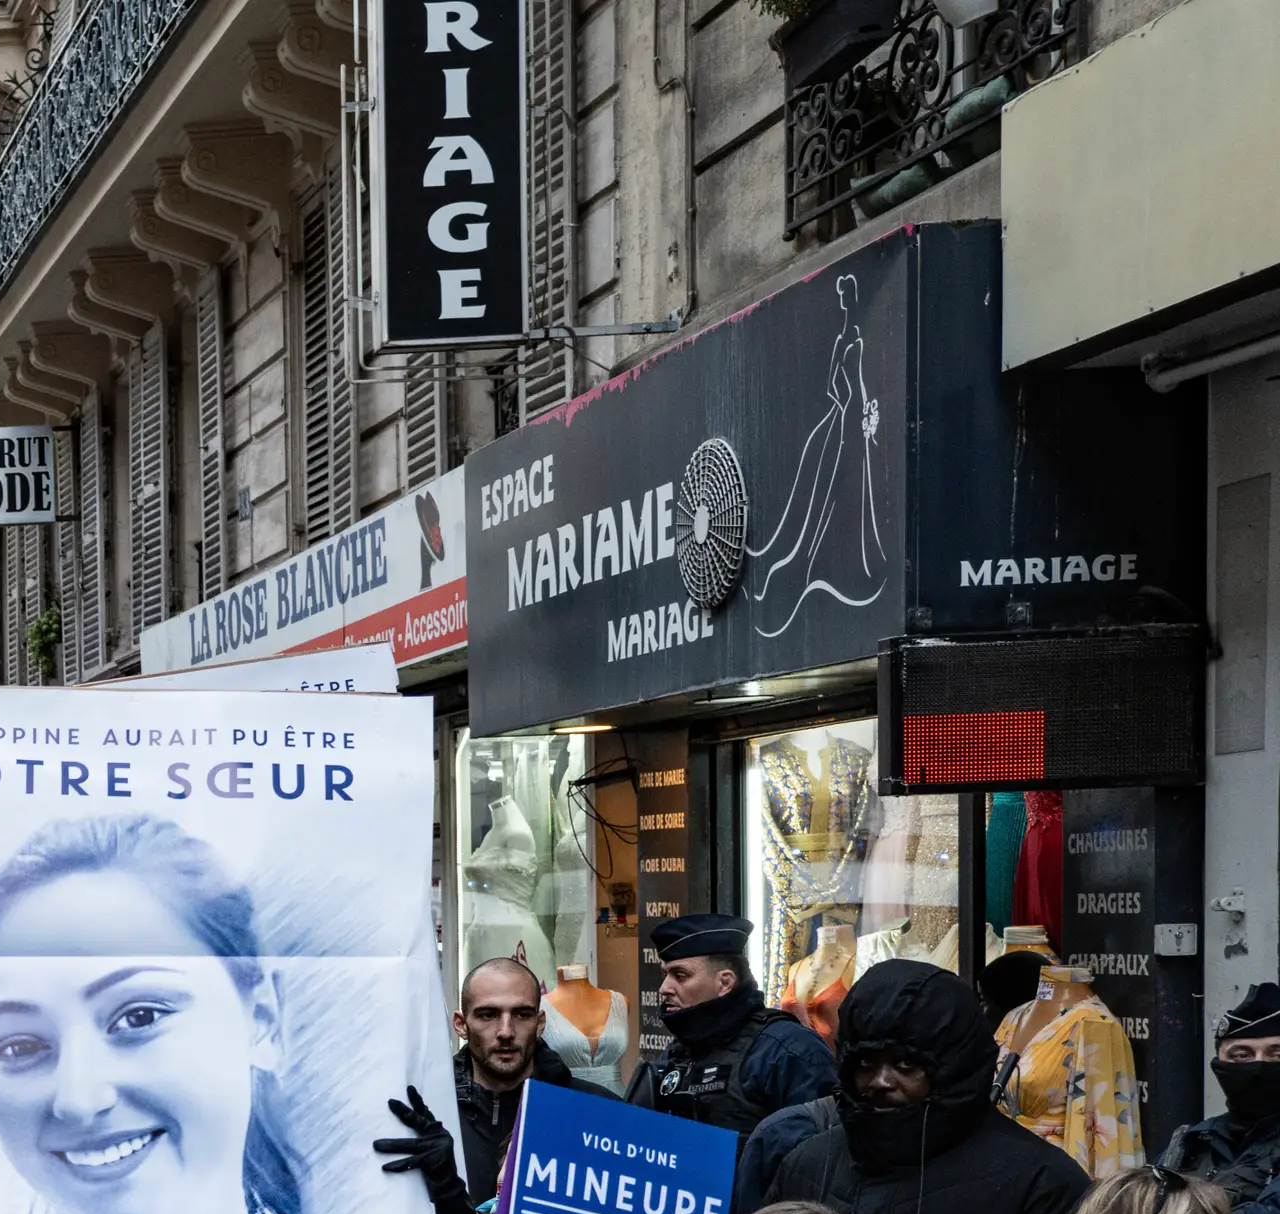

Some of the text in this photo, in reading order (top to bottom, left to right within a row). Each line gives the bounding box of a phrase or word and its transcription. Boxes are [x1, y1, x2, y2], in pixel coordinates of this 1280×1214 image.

[423, 1, 494, 319] RIAGE
[481, 454, 555, 531] ESPACE
[507, 482, 676, 612] MARIAME
[960, 554, 1137, 587] MARIAGE
[189, 517, 387, 665] LA ROSE BLANCHE
[608, 598, 714, 662] MARIAGE
[102, 727, 217, 746] AURAIT
[232, 729, 268, 746] PU
[284, 725, 355, 749] ÊTRE
[166, 761, 355, 801] SŒUR
[640, 812, 685, 831] ROBE DE SOIREE
[1068, 828, 1148, 855] CHAUSSURES
[640, 857, 685, 872] ROBE DUBAI
[646, 902, 679, 918] KAFTAN
[1077, 892, 1141, 914] DRAGEES
[1068, 953, 1149, 976] CHAPEAUX
[582, 1132, 677, 1169] VIOL D'UNE
